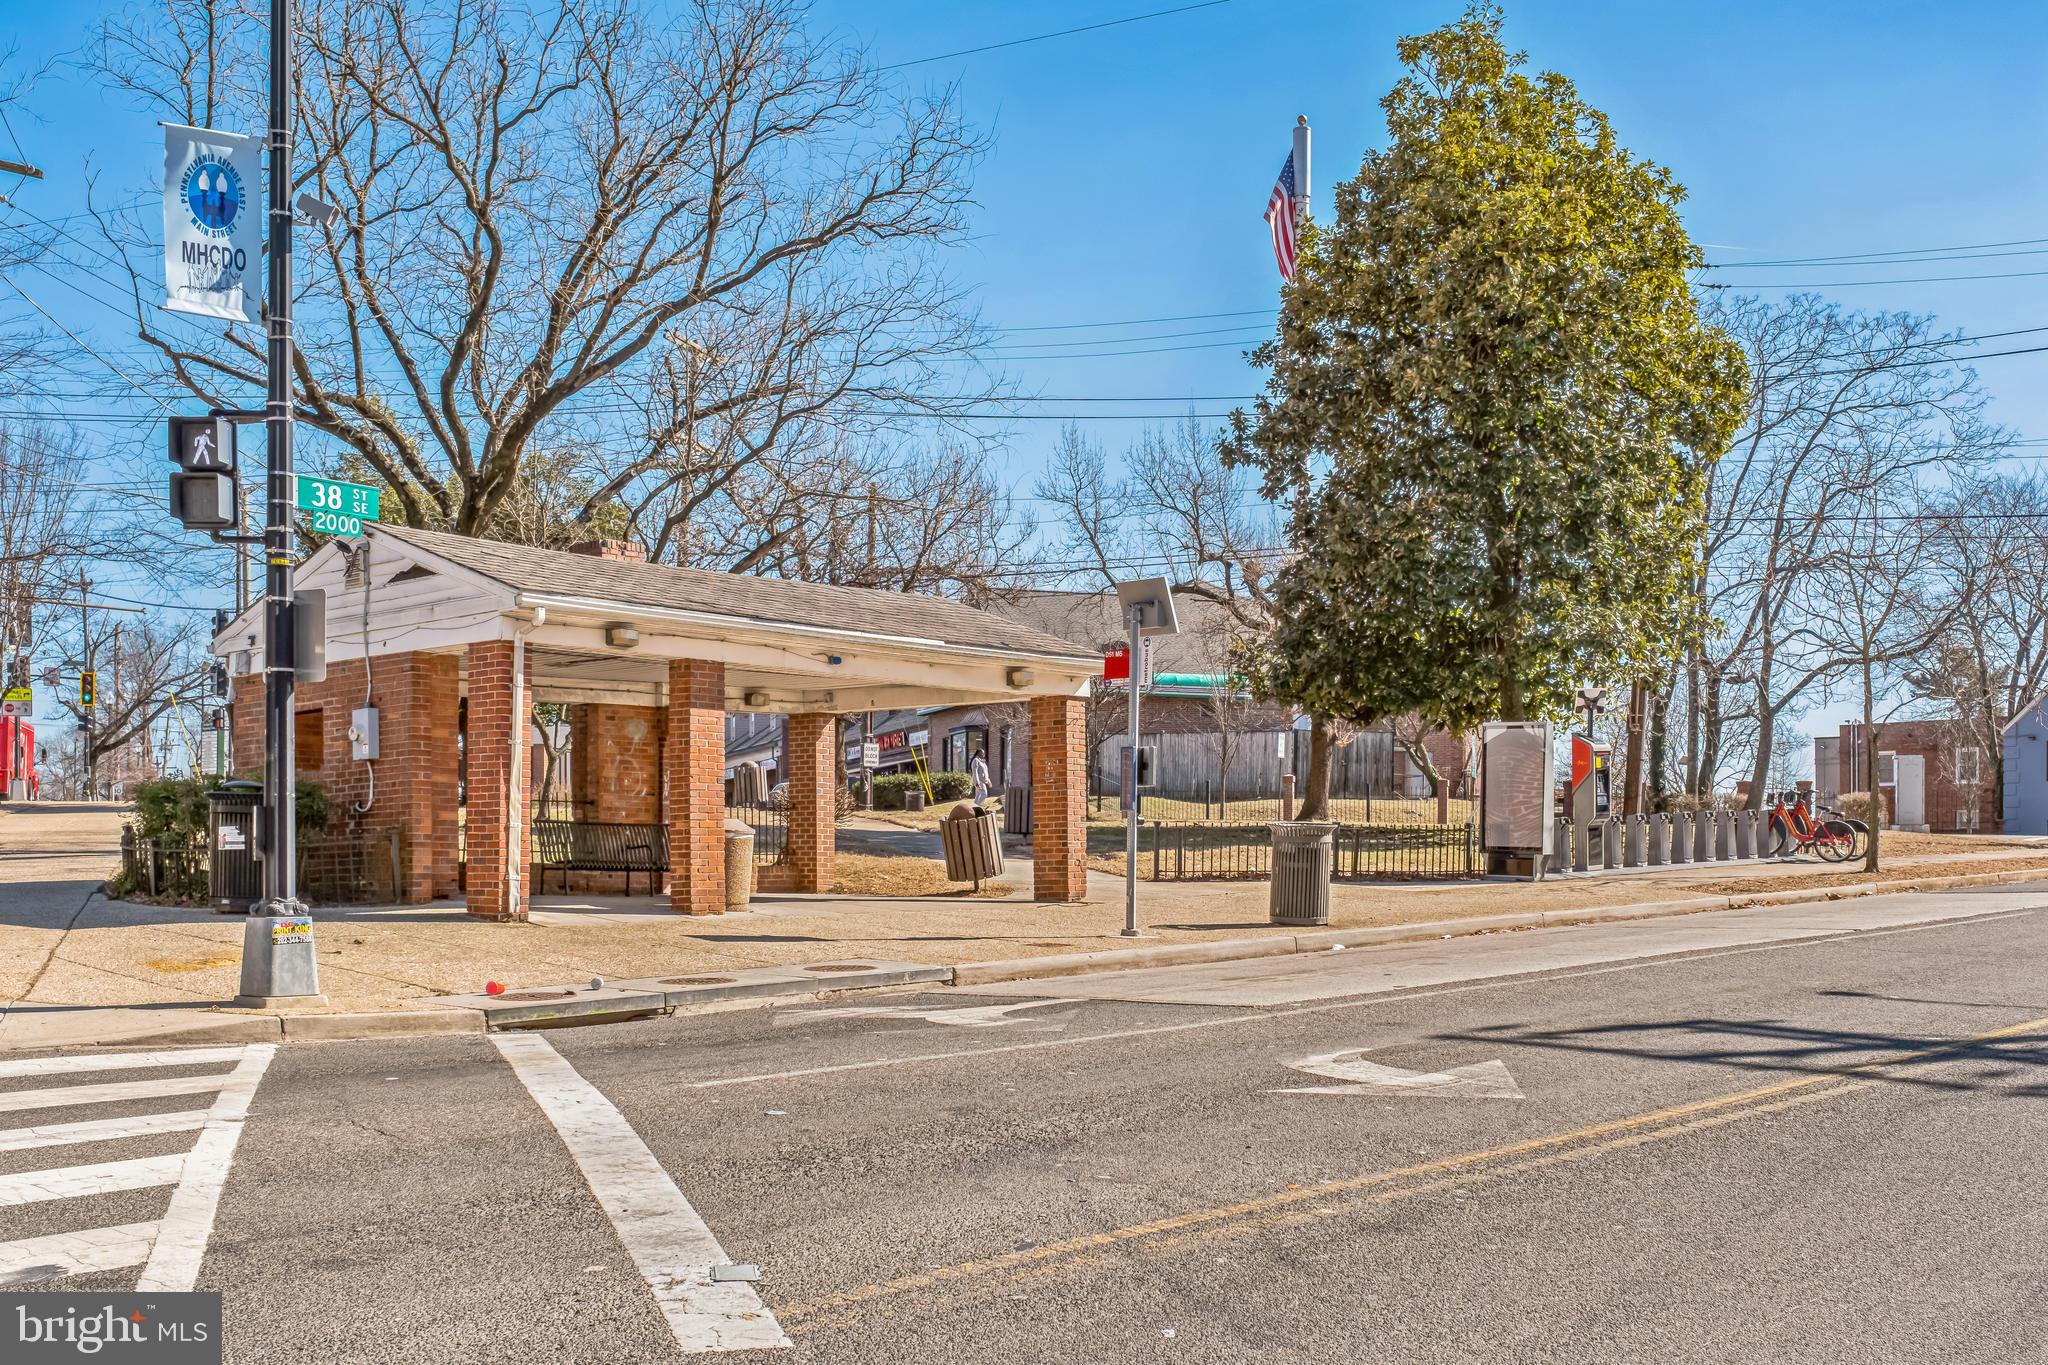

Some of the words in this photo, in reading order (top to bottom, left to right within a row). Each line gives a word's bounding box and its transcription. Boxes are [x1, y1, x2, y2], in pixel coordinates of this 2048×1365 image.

[181, 153, 215, 204] PENNSYLVANIA
[217, 155, 242, 186] AVENUE
[238, 185, 246, 212] EAST
[190, 216, 209, 237] MAIN
[212, 222, 238, 239] STREET
[182, 240, 247, 272] MHCDO
[311, 482, 343, 510] 38
[352, 488, 369, 501] ST
[352, 502, 369, 514] SE
[315, 512, 360, 535] 2000
[273, 926, 293, 935] PRINT
[295, 924, 311, 933] KING
